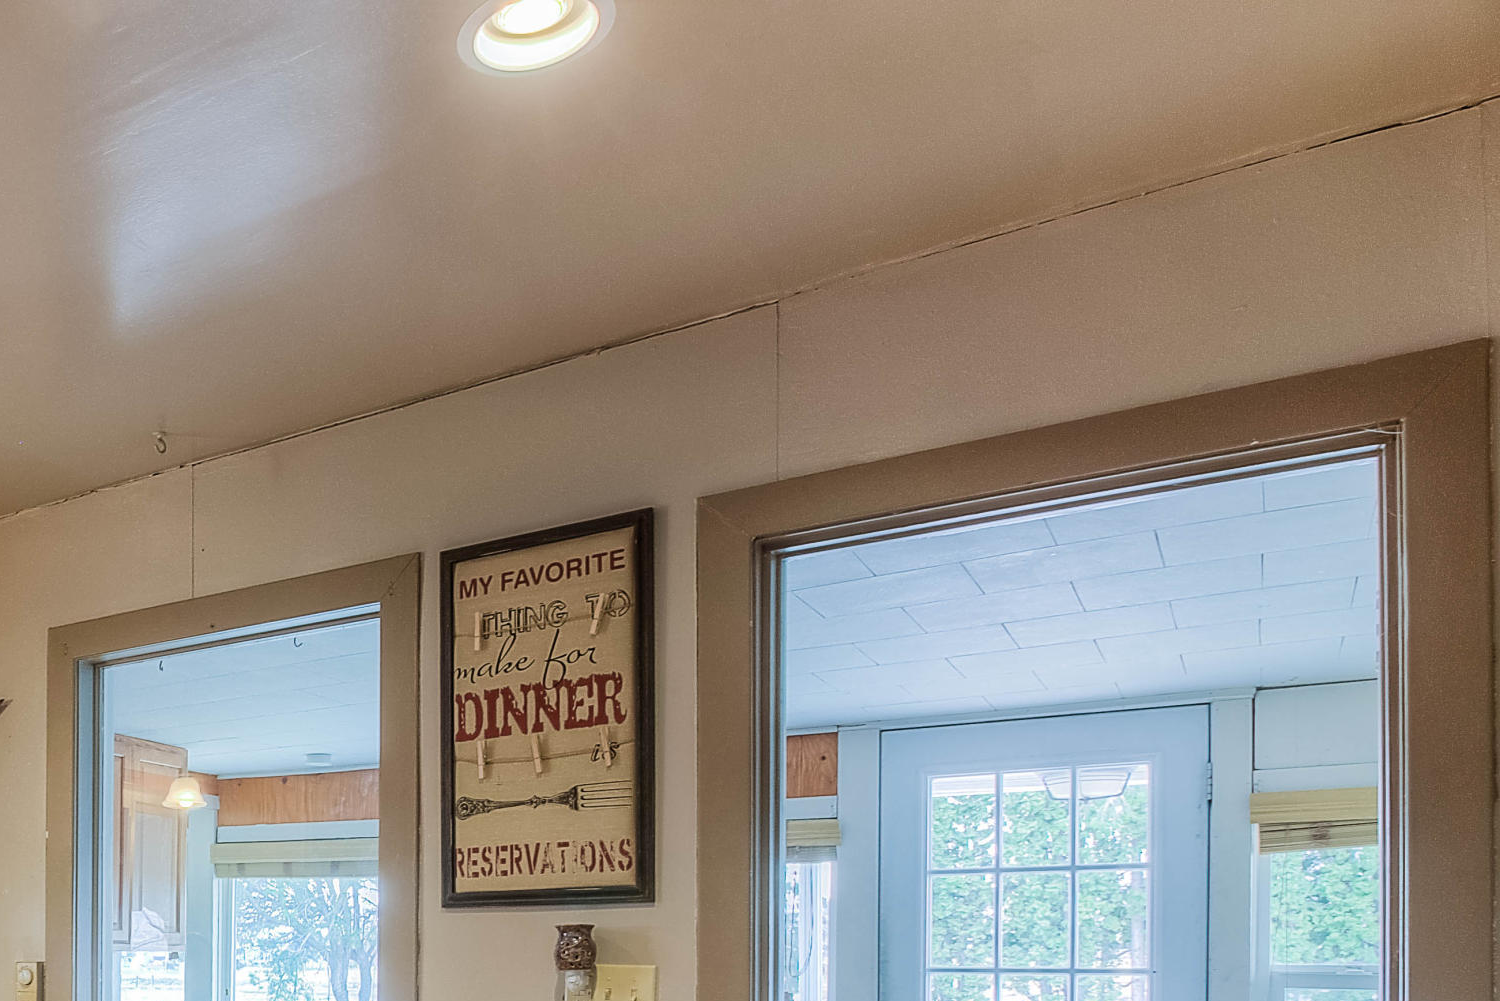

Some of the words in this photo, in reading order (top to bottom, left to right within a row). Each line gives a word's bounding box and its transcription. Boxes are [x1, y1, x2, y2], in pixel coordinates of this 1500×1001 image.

[459, 575, 493, 600] MY
[501, 548, 626, 591] FAVORITE
[482, 600, 568, 640] THING
[584, 589, 631, 619] TO
[455, 633, 536, 683] make
[543, 629, 596, 690] for
[454, 671, 628, 743] DINNER
[590, 742, 619, 762] is
[455, 838, 633, 879] RESERVATIONS
